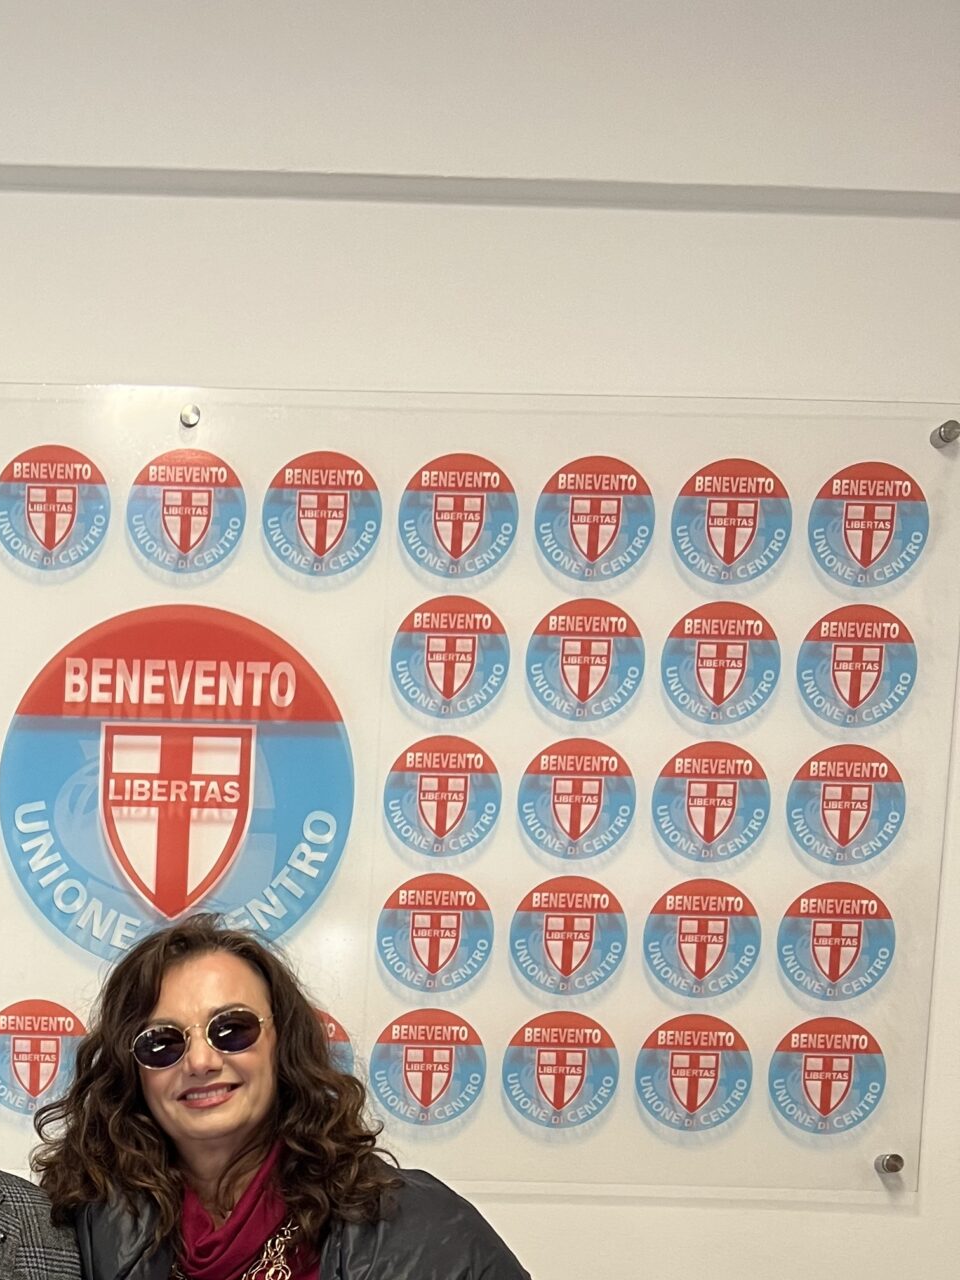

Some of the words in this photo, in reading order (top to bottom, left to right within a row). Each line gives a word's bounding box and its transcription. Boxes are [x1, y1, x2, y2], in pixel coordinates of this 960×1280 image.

[12, 462, 91, 480] BENEVENTO
[148, 466, 228, 484] BENEVENTO
[284, 469, 364, 486] BENEVENTO
[421, 471, 500, 488] BENEVENTO
[557, 473, 637, 491] BENEVENTO
[695, 476, 775, 494] BENEVENTO
[832, 479, 912, 497] BENEVENTO
[27, 503, 73, 513] LIBERTAS
[163, 506, 209, 516] LIBERTAS
[298, 509, 345, 519] LIBERTAS
[435, 511, 481, 521] LIBERTAS
[571, 514, 617, 524] LIBERTAS
[708, 517, 754, 527] LIBERTAS
[845, 520, 891, 530] LIBERTAS
[403, 519, 446, 571] UNIONE
[464, 522, 513, 573] CENTRO
[539, 522, 582, 574] UNIONE
[600, 525, 649, 576] CENTRO
[676, 525, 718, 576] UNIONE
[736, 528, 786, 578] CENTRO
[813, 528, 855, 579] UNIONE
[873, 531, 923, 581] CENTRO
[413, 613, 492, 630] BENEVENTO
[548, 616, 627, 633] BENEVENTO
[684, 619, 763, 636] BENEVENTO
[820, 622, 900, 639] BENEVENTO
[427, 652, 473, 662] LIBERTAS
[562, 655, 608, 665] LIBERTAS
[697, 658, 743, 668] LIBERTAS
[833, 661, 880, 671] LIBERTAS
[64, 657, 297, 707] BENEVENTO
[396, 660, 438, 711] UNIONE
[456, 663, 504, 713] CENTRO
[531, 663, 573, 713] UNIONE
[591, 666, 640, 716] CENTRO
[666, 666, 708, 717] UNIONE
[726, 669, 775, 719] CENTRO
[802, 669, 844, 720] UNIONE
[862, 672, 911, 722] CENTRO
[405, 752, 484, 769] BENEVENTO
[540, 755, 618, 772] BENEVENTO
[674, 758, 753, 775] BENEVENTO
[809, 761, 889, 778] BENEVENTO
[108, 778, 241, 803] LIBERTAS
[419, 791, 465, 801] LIBERTAS
[553, 794, 599, 804] LIBERTAS
[688, 797, 734, 807] LIBERTAS
[823, 800, 869, 810] LIBERTAS
[389, 799, 431, 849] UNIONE
[448, 802, 496, 851] CENTRO
[523, 802, 565, 852] UNIONE
[582, 805, 631, 854] CENTRO
[791, 808, 833, 858] UNIONE
[851, 811, 900, 860] CENTRO
[14, 800, 141, 949] UNIONE
[223, 810, 337, 930] ENTRO
[398, 890, 476, 906] BENEVENTO
[532, 893, 610, 909] BENEVENTO
[665, 895, 744, 912] BENEVENTO
[799, 898, 878, 915] BENEVENTO
[412, 928, 457, 938] LIBERTAS
[545, 931, 591, 941] LIBERTAS
[679, 934, 724, 944] LIBERTAS
[813, 937, 858, 947] LIBERTAS
[382, 936, 423, 985] UNIONE
[441, 939, 489, 987] CENTRO
[648, 941, 690, 990] UNIONE
[708, 944, 756, 992] CENTRO
[0, 1015, 74, 1032] BENEVENTO
[391, 1025, 468, 1041] BENEVENTO
[524, 1027, 602, 1044] BENEVENTO
[657, 1030, 735, 1047] BENEVENTO
[790, 1033, 869, 1050] BENEVENTO
[14, 1053, 57, 1062] LIBERTAS
[405, 1062, 450, 1072] LIBERTAS
[537, 1065, 583, 1075] LIBERTAS
[671, 1068, 716, 1078] LIBERTAS
[804, 1071, 849, 1081] LIBERTAS
[507, 1073, 549, 1121] UNIONE
[566, 1076, 614, 1123] CENTRO
[773, 1078, 815, 1127] UNIONE
[833, 1082, 881, 1129] CENTRO
